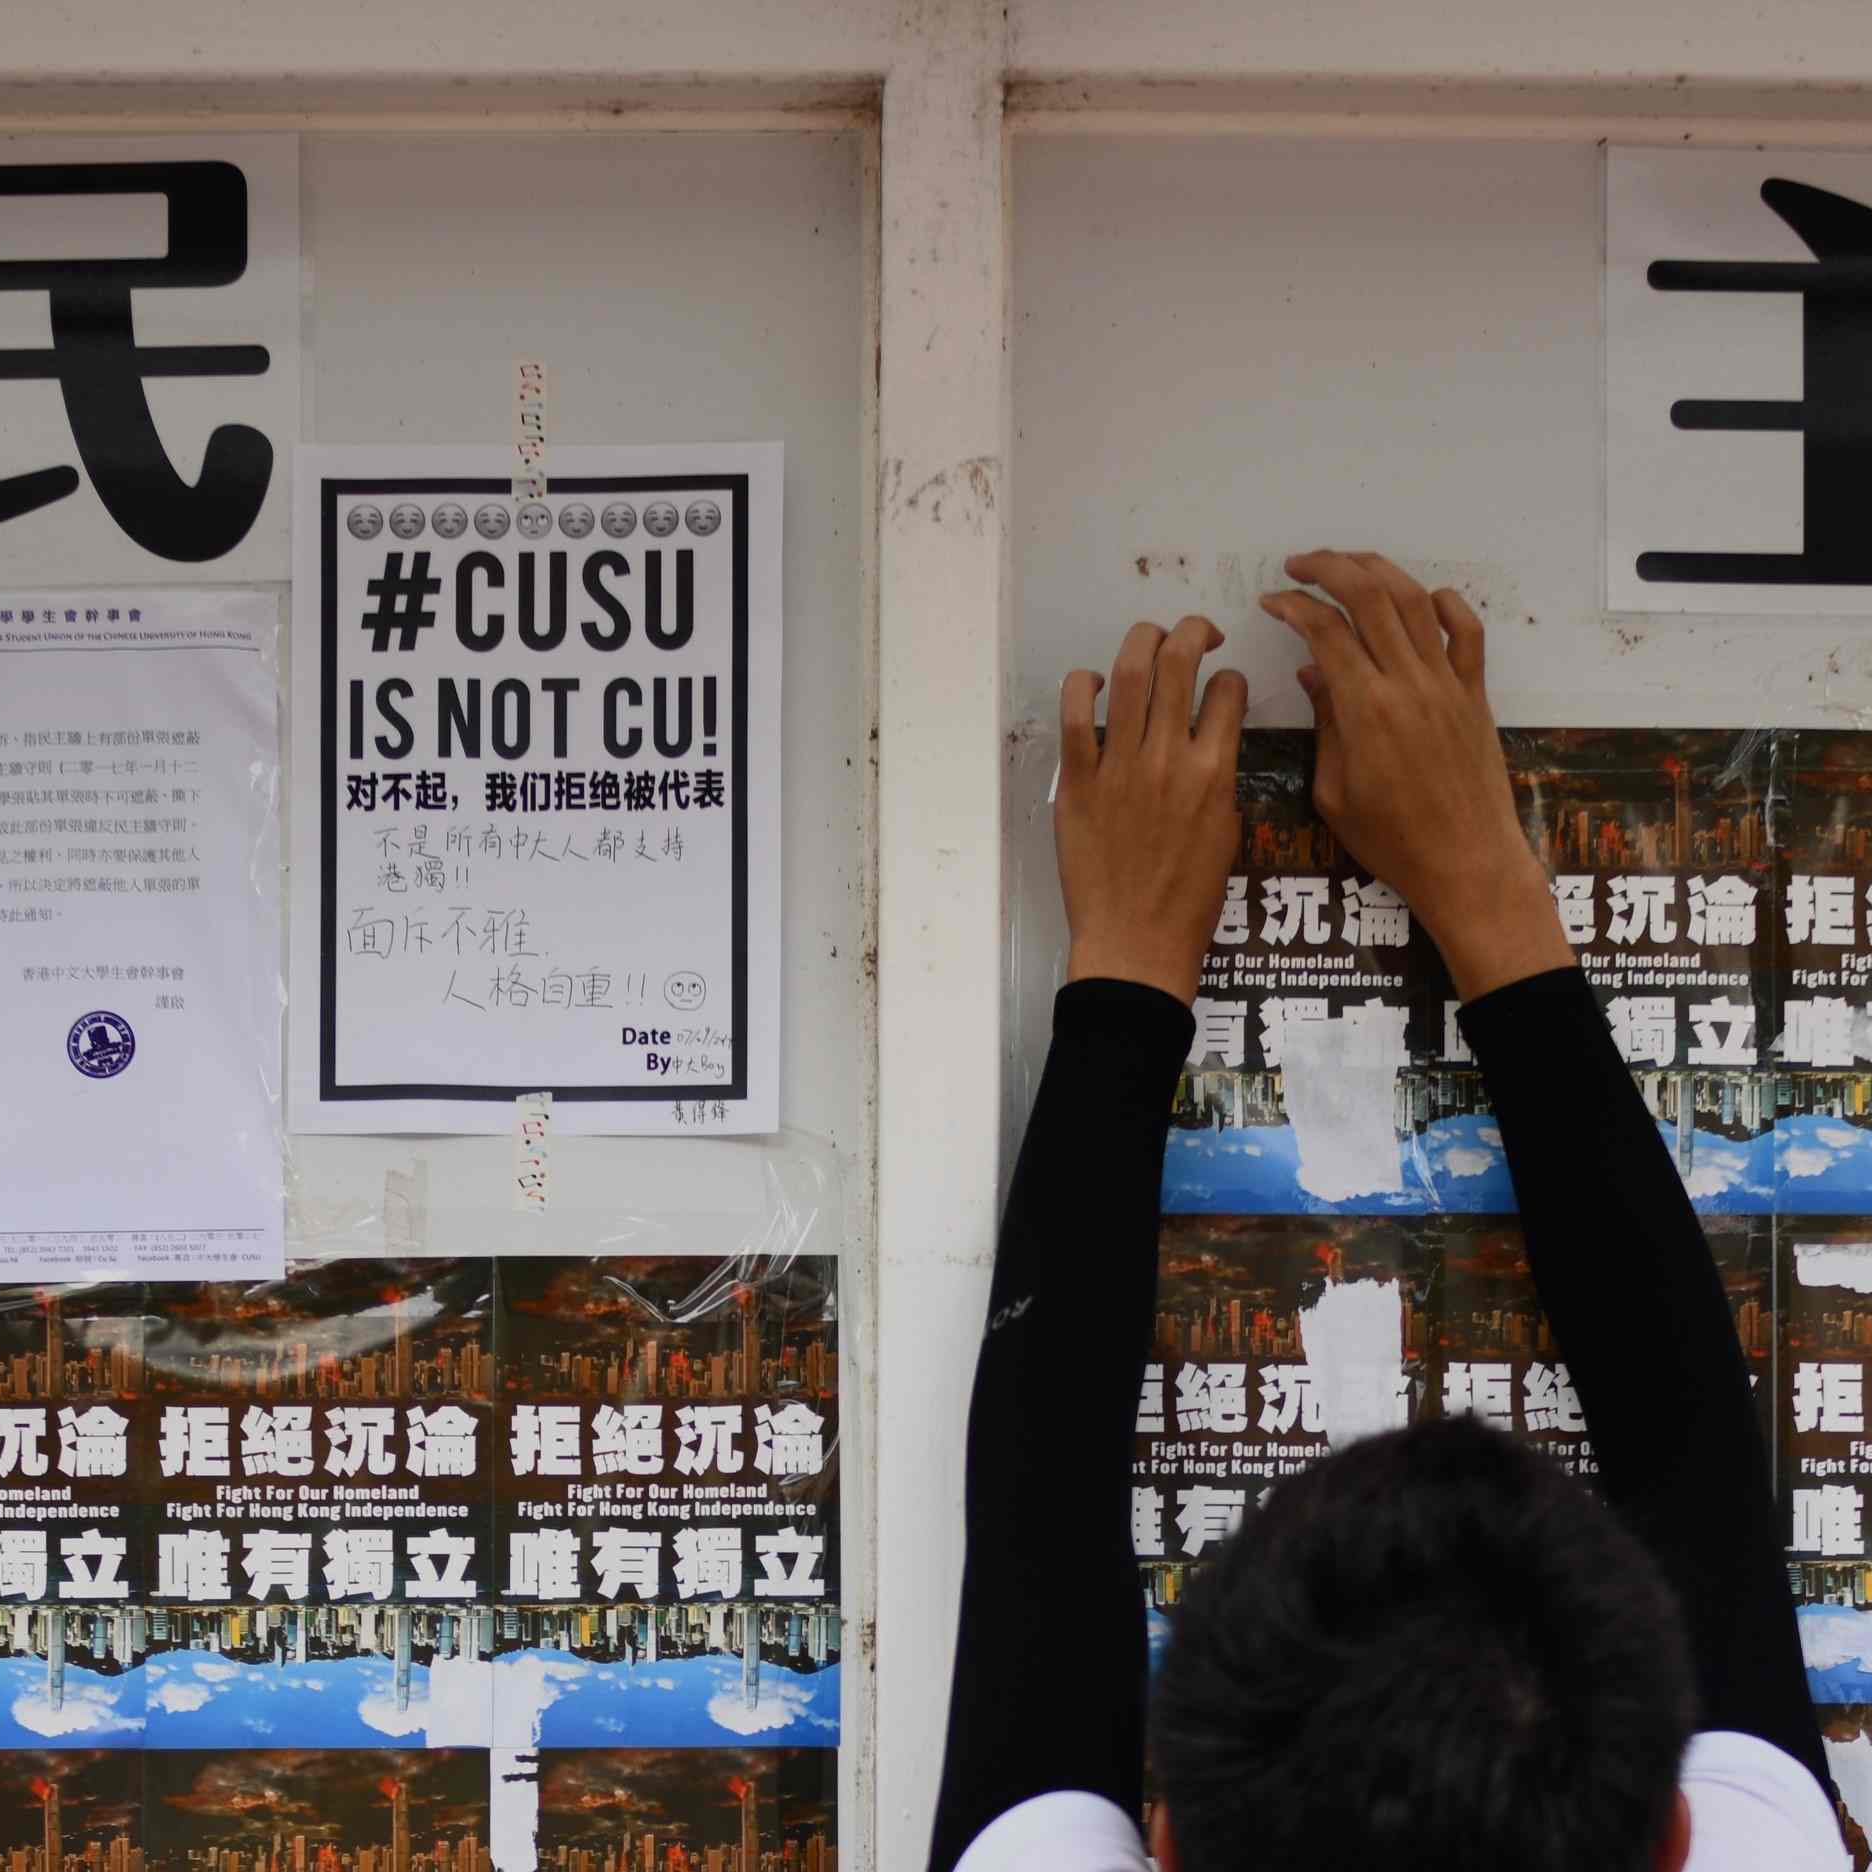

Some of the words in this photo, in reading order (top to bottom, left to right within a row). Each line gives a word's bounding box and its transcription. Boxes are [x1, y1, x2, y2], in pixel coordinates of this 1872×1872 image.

[361, 550, 694, 652] #CUSU
[349, 676, 414, 760] IS
[438, 677, 579, 759] NOT
[603, 675, 718, 759] CU!
[346, 770, 725, 812] 对不起，我们拒绝被代表
[622, 1027, 671, 1046] Date
[647, 1053, 671, 1075] By
[159, 1406, 478, 1477] 拒絕沉淪
[157, 1528, 476, 1601] 唯有獨立
